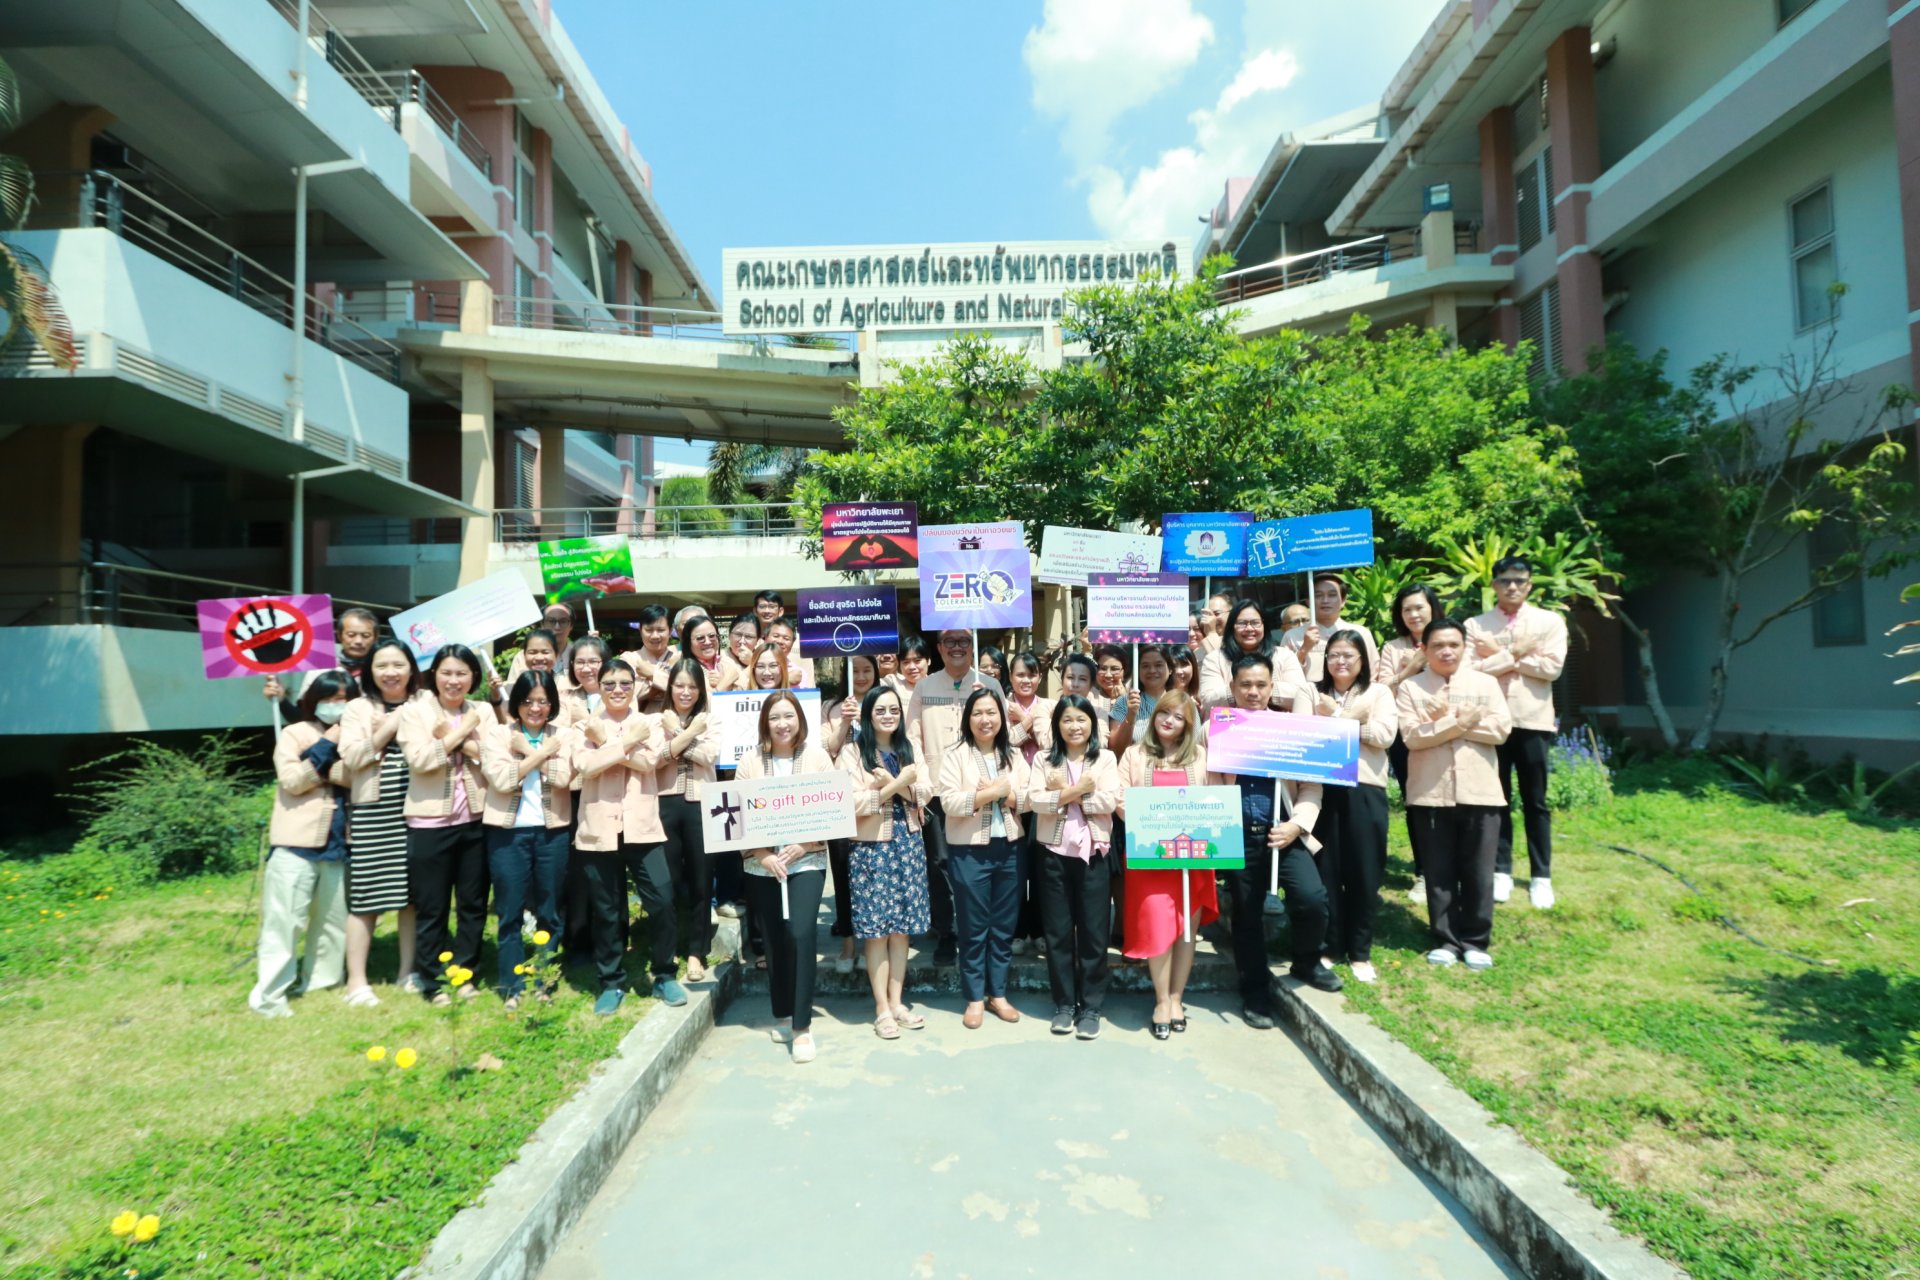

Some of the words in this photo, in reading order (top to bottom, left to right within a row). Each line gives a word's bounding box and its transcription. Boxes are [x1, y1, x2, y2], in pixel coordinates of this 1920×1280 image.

[736, 241, 1178, 290] คณะเกษตรศาสตร์และทรัพยากรธรรมชาติ
[739, 297, 804, 328] School
[813, 298, 832, 323] of
[840, 295, 945, 329] Agriculture
[954, 294, 989, 321] and
[998, 293, 1067, 321] Natural
[835, 507, 904, 517] มหาวิทยาลัยพะเยา
[935, 570, 1014, 602] ZERO
[935, 598, 983, 606] TOLERANCE
[772, 794, 795, 810] gift
[801, 789, 844, 806] policy
[1149, 801, 1224, 811] มหาวิทยาลัยพะเยา
